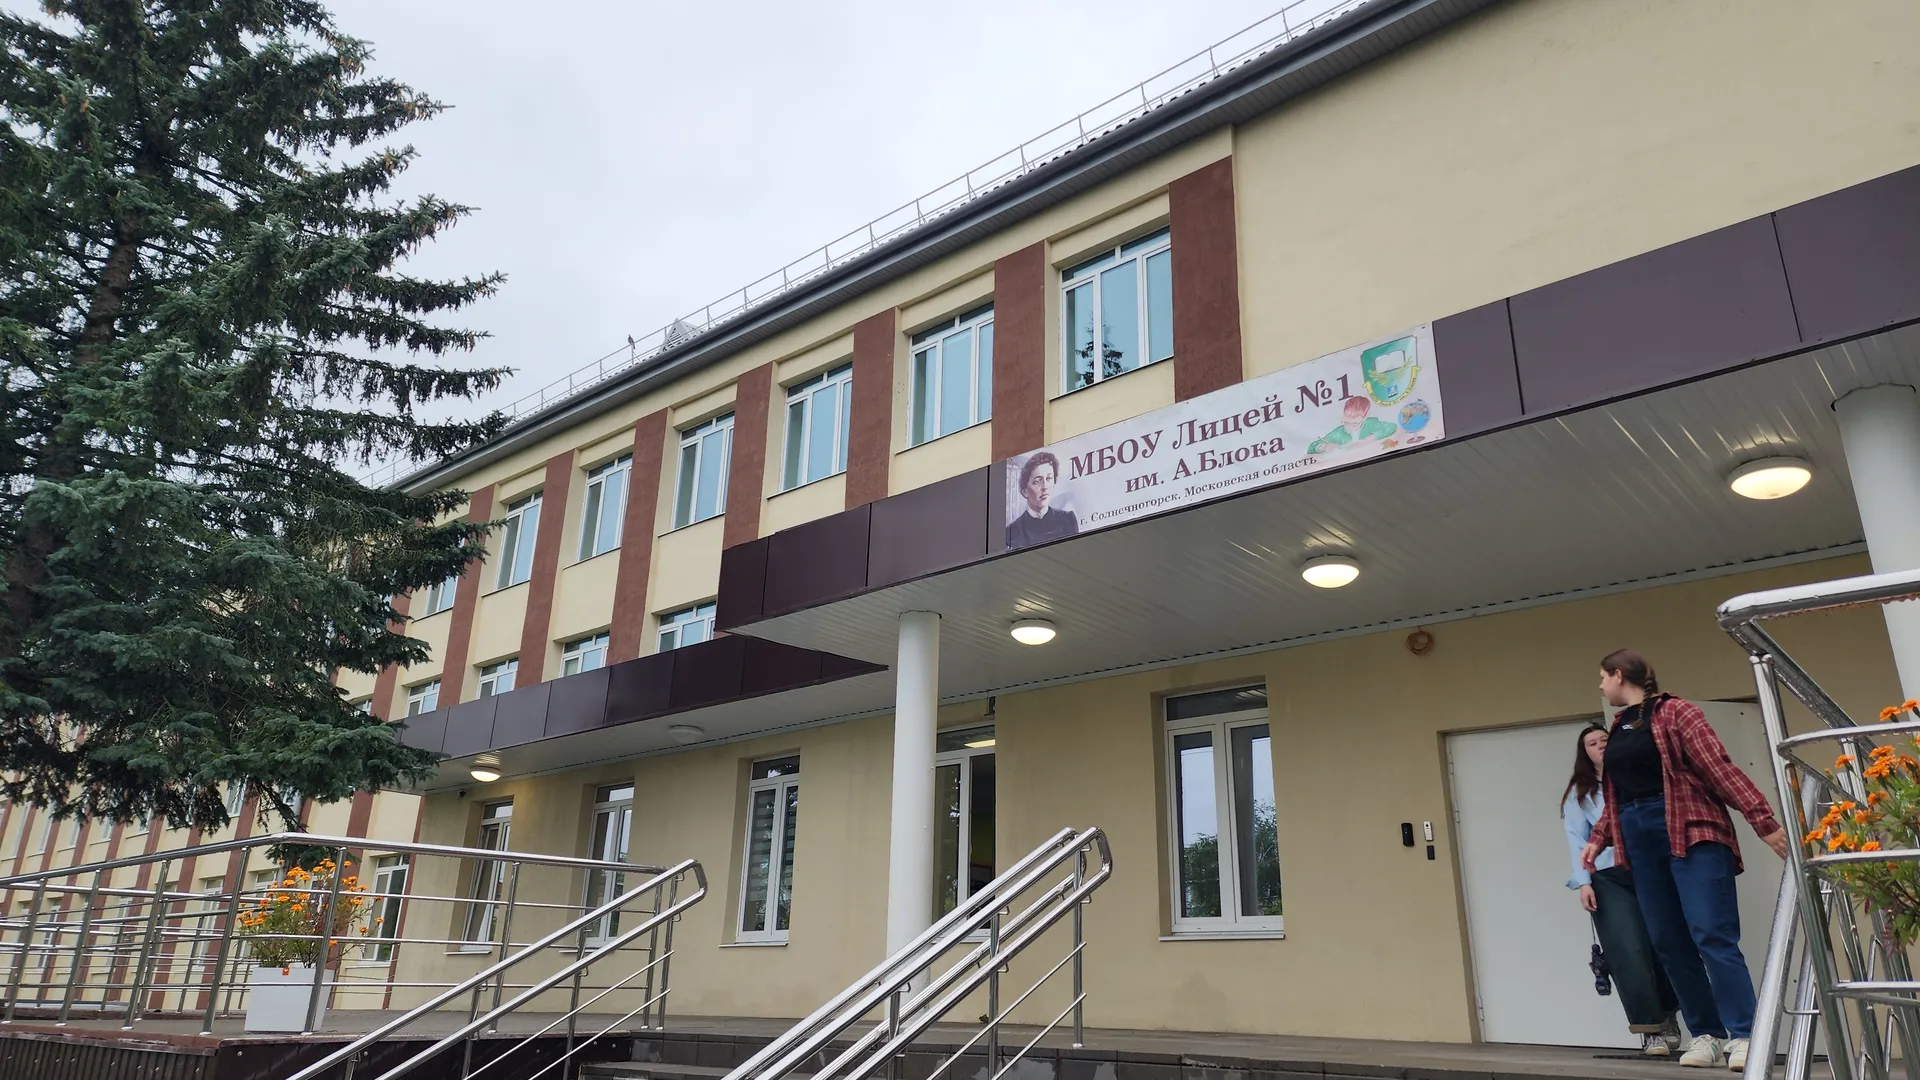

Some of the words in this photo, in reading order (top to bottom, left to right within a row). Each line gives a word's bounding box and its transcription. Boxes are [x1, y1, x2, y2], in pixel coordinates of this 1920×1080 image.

[1069, 429, 1163, 481] МБОУ
[1172, 394, 1284, 450] Лицей
[1294, 373, 1354, 413] №1
[1080, 517, 1088, 525] г.
[1184, 468, 1260, 499] Московская
[1263, 455, 1317, 477] область
[1125, 471, 1164, 493] им.
[1172, 436, 1285, 481] А.Блока
